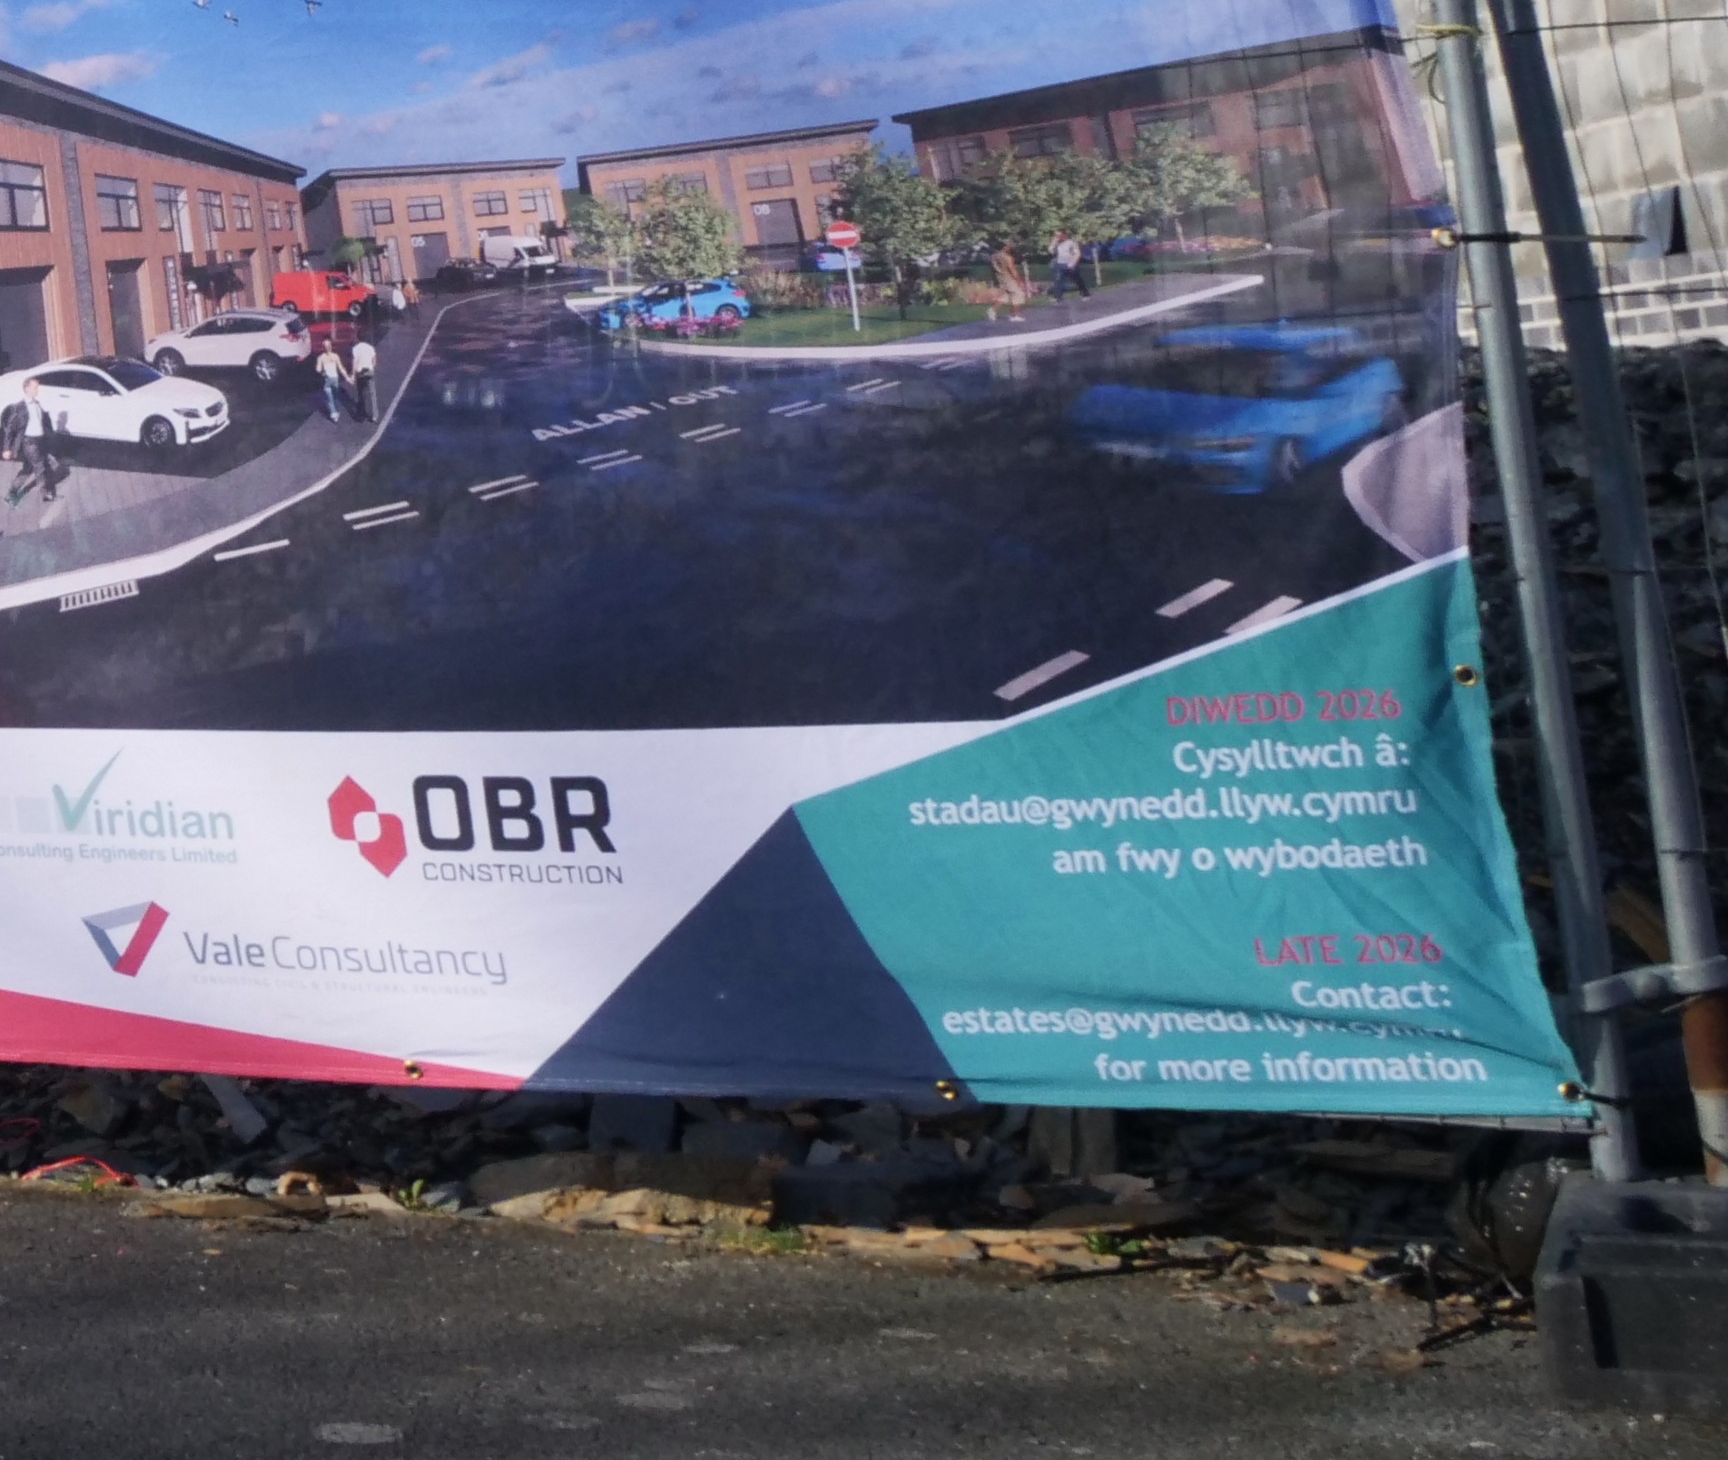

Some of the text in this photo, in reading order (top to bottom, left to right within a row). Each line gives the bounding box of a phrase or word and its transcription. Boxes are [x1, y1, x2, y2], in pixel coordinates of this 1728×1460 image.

[532, 405, 651, 441] ALLAN
[668, 385, 738, 405] OUT
[1166, 688, 1402, 727] DIWEDD 2026
[1173, 732, 1411, 777] Cysylltwch â:
[52, 744, 234, 839] Viridian
[909, 787, 1418, 831] stadau@gwynedd.llyw.cymru
[412, 773, 617, 853] OBR
[79, 844, 166, 863] Engineers
[172, 847, 237, 864] Limited
[422, 860, 624, 884] CONSTRUCTION
[1053, 835, 1427, 880] am fwy o wybodaeth
[1255, 933, 1442, 967] LATE 2026
[1292, 979, 1451, 1010] Contact:
[1094, 1050, 1488, 1083] for more information
